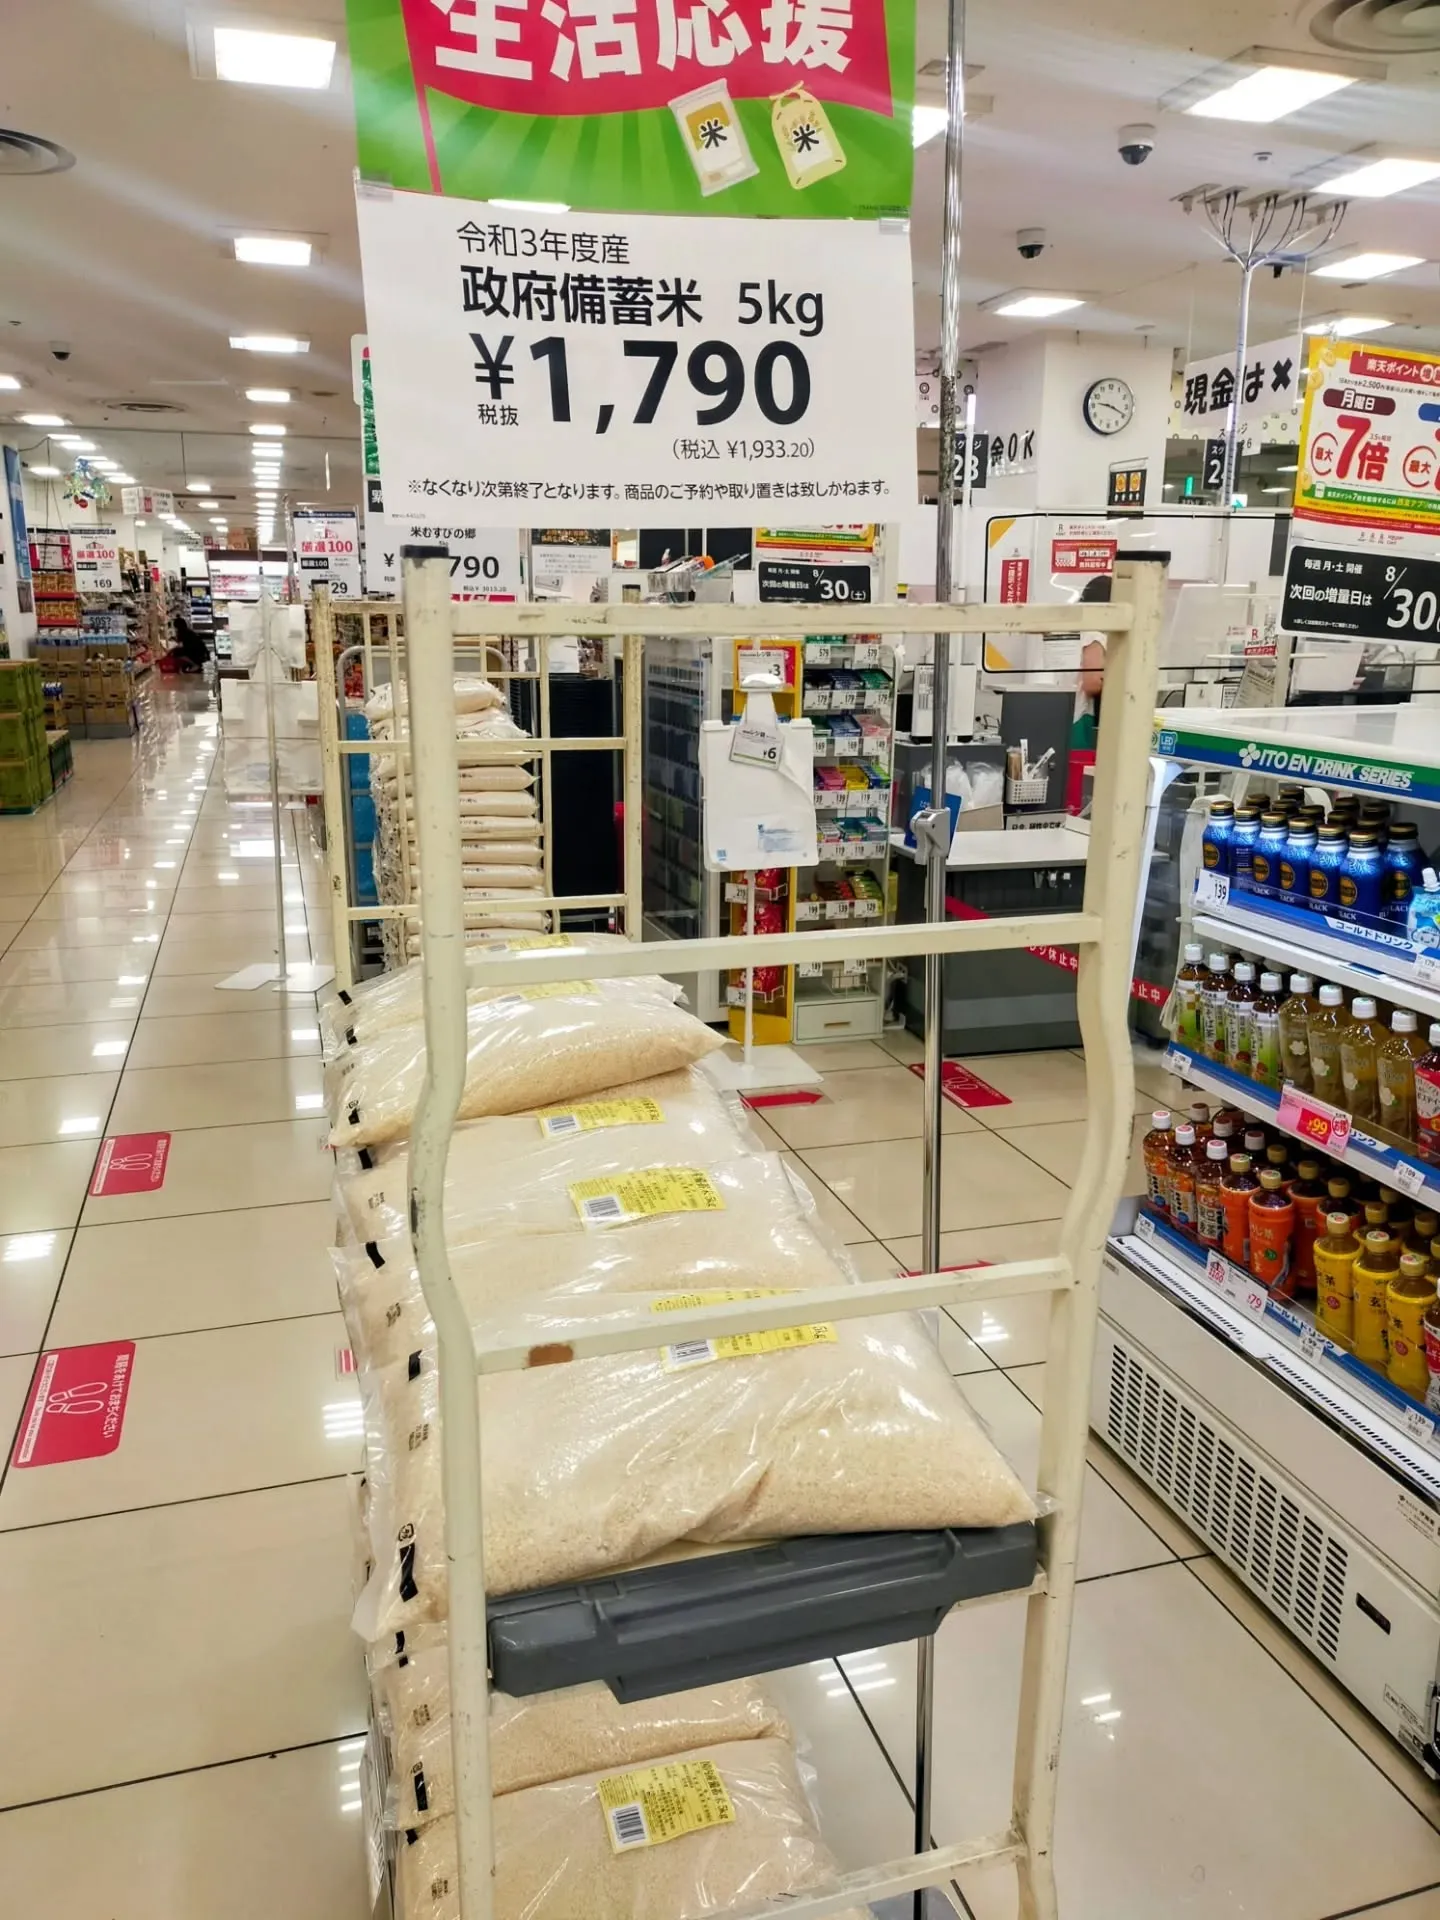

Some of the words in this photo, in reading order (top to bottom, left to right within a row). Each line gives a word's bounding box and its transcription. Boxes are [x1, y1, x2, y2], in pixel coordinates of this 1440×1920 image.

[435, 0, 853, 81] 生活応援
[701, 119, 728, 149] 米
[793, 123, 820, 153] 米
[457, 219, 631, 266] 令和3年度産
[460, 264, 703, 328] 政府備蓄米
[737, 279, 825, 337] 5kg
[468, 332, 812, 434] ¥1,790
[1340, 389, 1376, 411] 月曜日
[477, 404, 520, 427] 税抜
[1315, 447, 1334, 463] 最大
[1336, 414, 1390, 481] 7倍
[1408, 459, 1432, 475] 最大
[410, 526, 477, 539] 米むすびの郷
[1289, 583, 1373, 607] 次回の増量日は
[1161, 735, 1174, 746] LED
[1258, 749, 1289, 768] ITO
[1287, 753, 1313, 774] EN
[1312, 758, 1358, 781] DRINK
[1358, 766, 1413, 790] SERIES
[1213, 883, 1227, 901] 139
[1335, 920, 1414, 951] コールドドリンク
